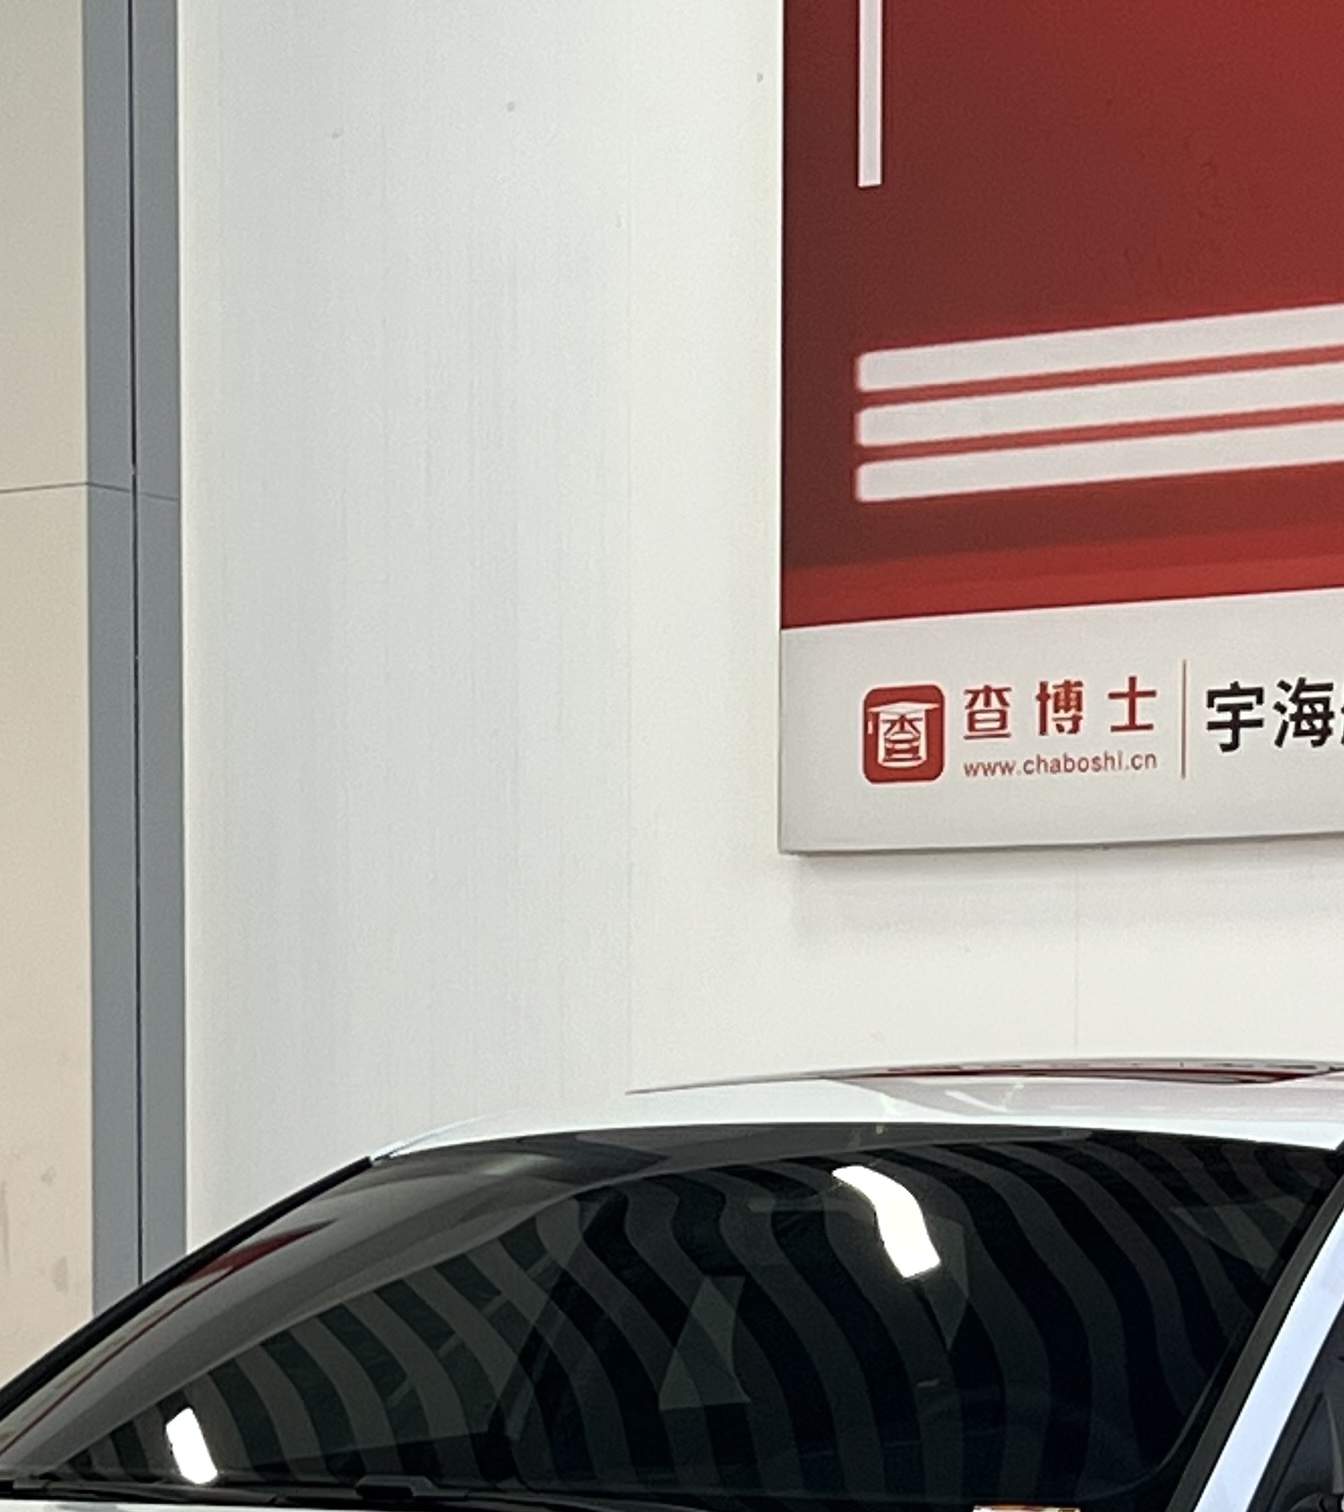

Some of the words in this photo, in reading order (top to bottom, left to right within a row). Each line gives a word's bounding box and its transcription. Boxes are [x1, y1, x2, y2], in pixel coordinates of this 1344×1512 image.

[963, 676, 1158, 740] 查博士
[962, 749, 1159, 778] www.chaboshi.cn
